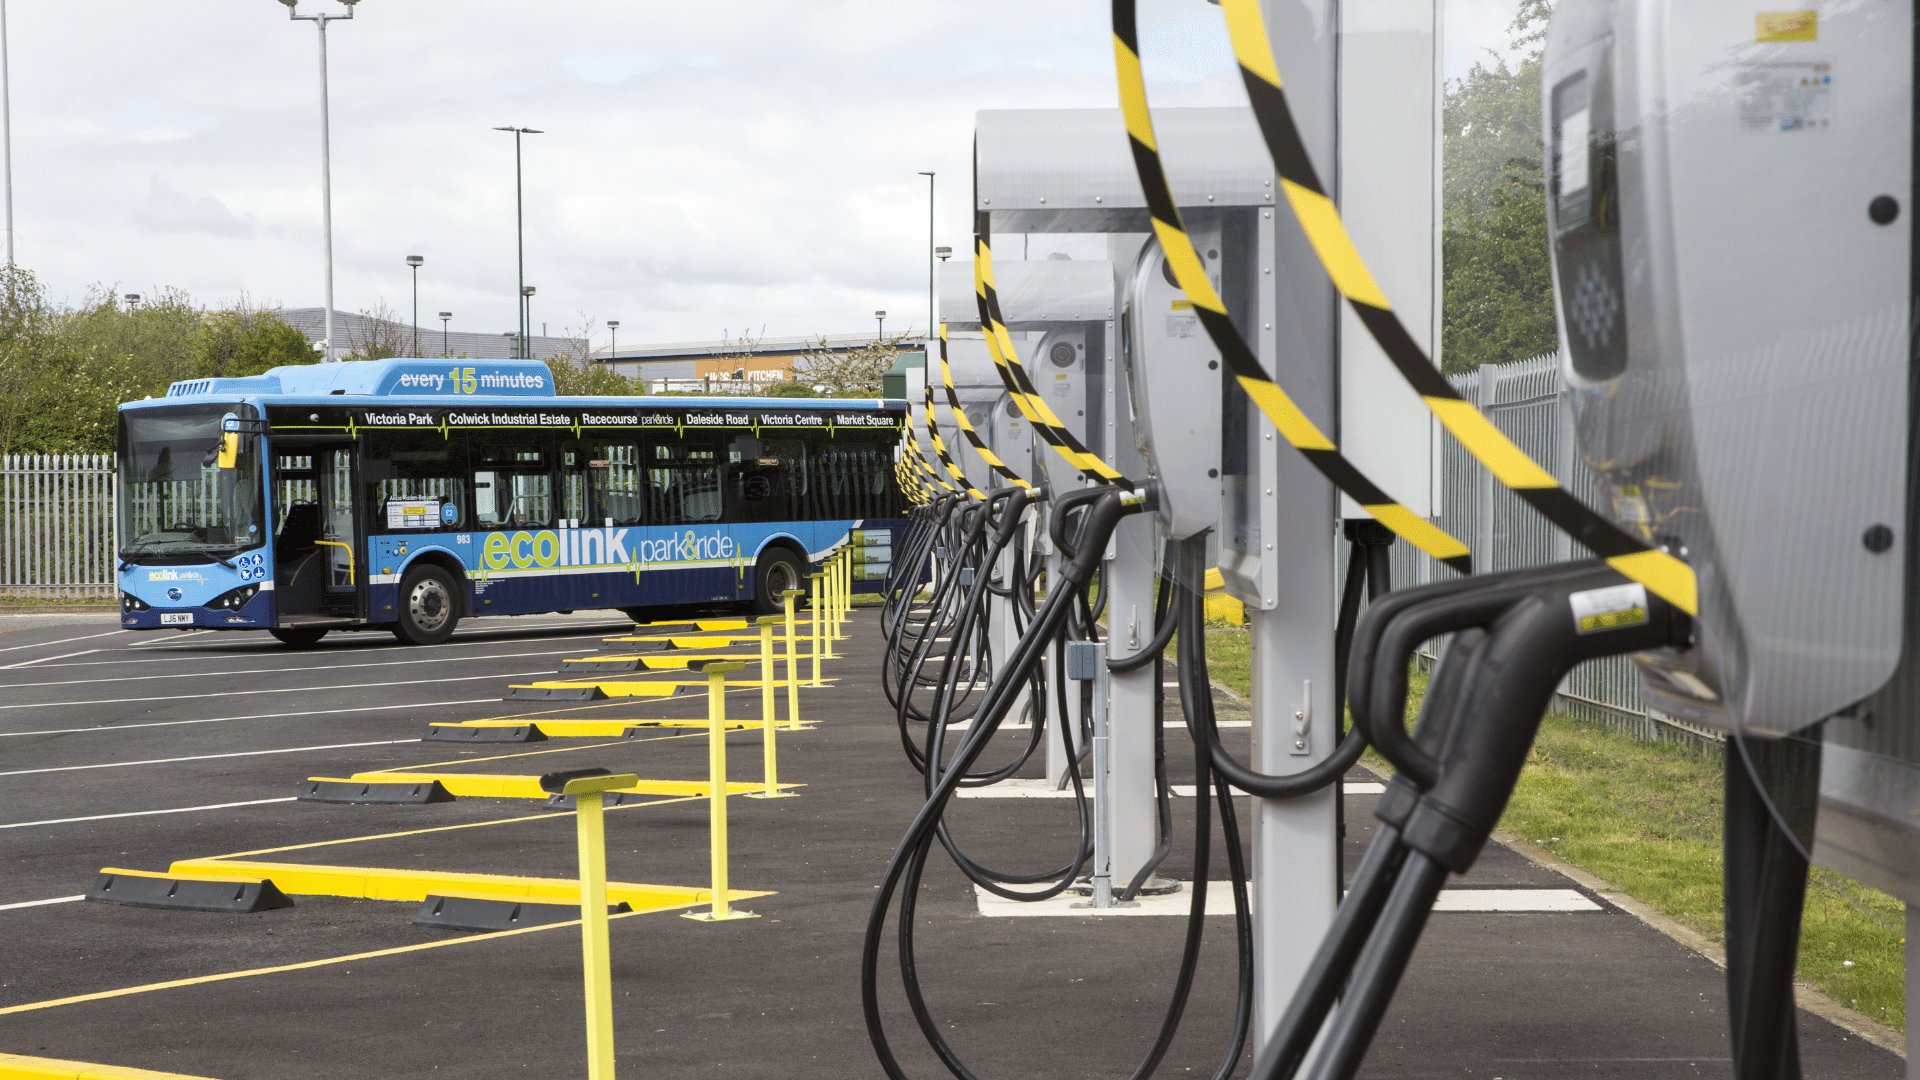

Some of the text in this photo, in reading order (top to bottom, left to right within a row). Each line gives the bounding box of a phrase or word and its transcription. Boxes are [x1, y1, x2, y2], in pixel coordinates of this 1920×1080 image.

[401, 367, 544, 394] every 15 minutes
[365, 413, 434, 425] Victoria Park
[449, 413, 571, 425] Colwick Industrial Estate
[582, 413, 674, 427] Racecourse park&ride
[686, 413, 749, 425] Daleside Road
[761, 414, 822, 425] Victoria Centre
[836, 414, 894, 427] Market Square
[445, 509, 454, 517] £2
[456, 535, 470, 544] 983
[484, 517, 733, 570] ecolink park&ride
